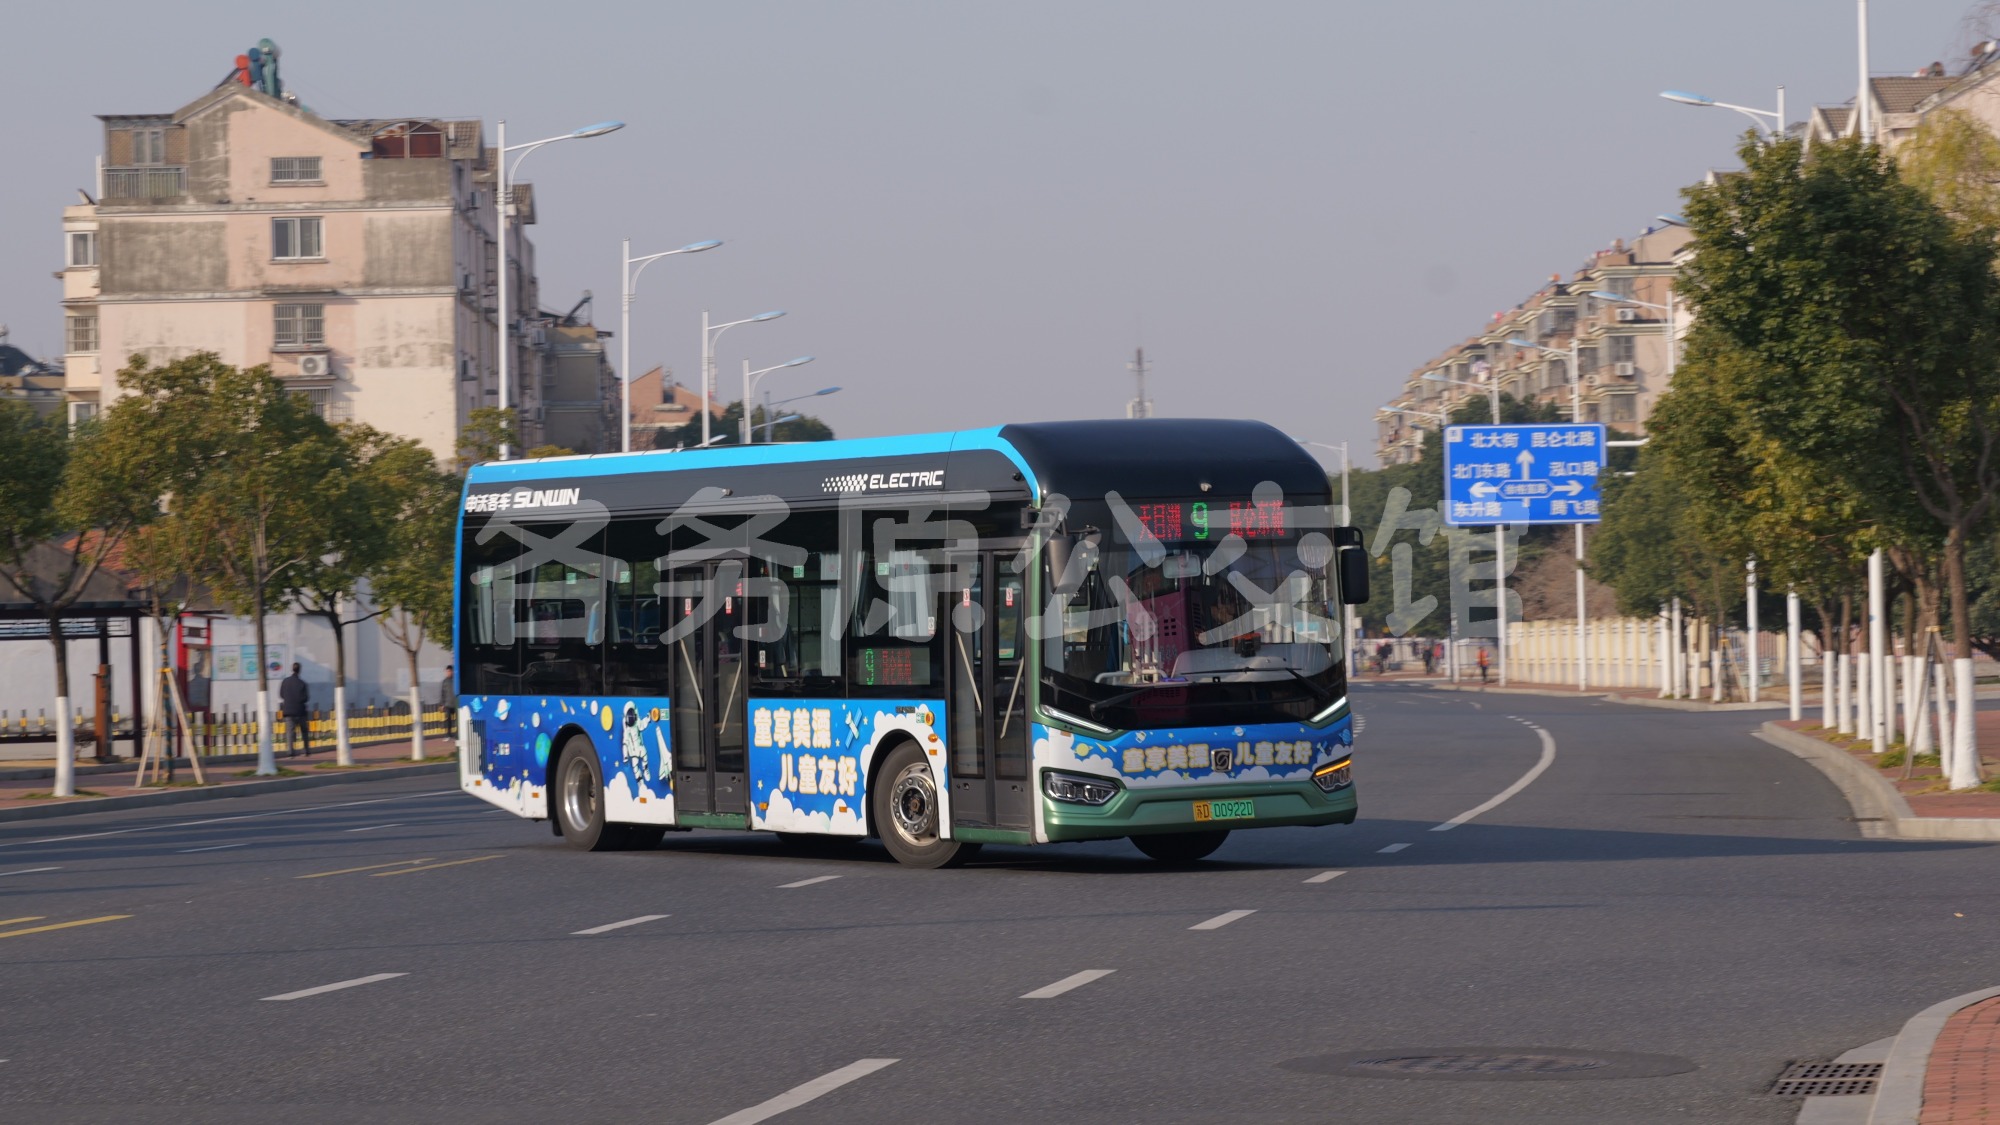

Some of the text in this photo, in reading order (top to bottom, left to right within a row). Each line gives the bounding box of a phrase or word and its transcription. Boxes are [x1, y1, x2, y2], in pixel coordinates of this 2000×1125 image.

[1469, 431, 1595, 448] 北大街 昆仑北路
[1452, 463, 1511, 479] 北门东路
[1549, 460, 1598, 476] 泓口路
[869, 470, 944, 489] ELECTRIC
[464, 493, 511, 512] 申沃客车
[512, 487, 580, 508] SUNWIN
[1452, 501, 1503, 517] 东升路
[1550, 500, 1599, 515] 腾飞路
[1139, 502, 1182, 541] 天目湖
[1192, 502, 1209, 539] 9
[865, 648, 875, 685] 9
[753, 707, 833, 749] 童享美溧
[1234, 741, 1312, 766] 儿童友好
[778, 753, 858, 797] 儿童友好
